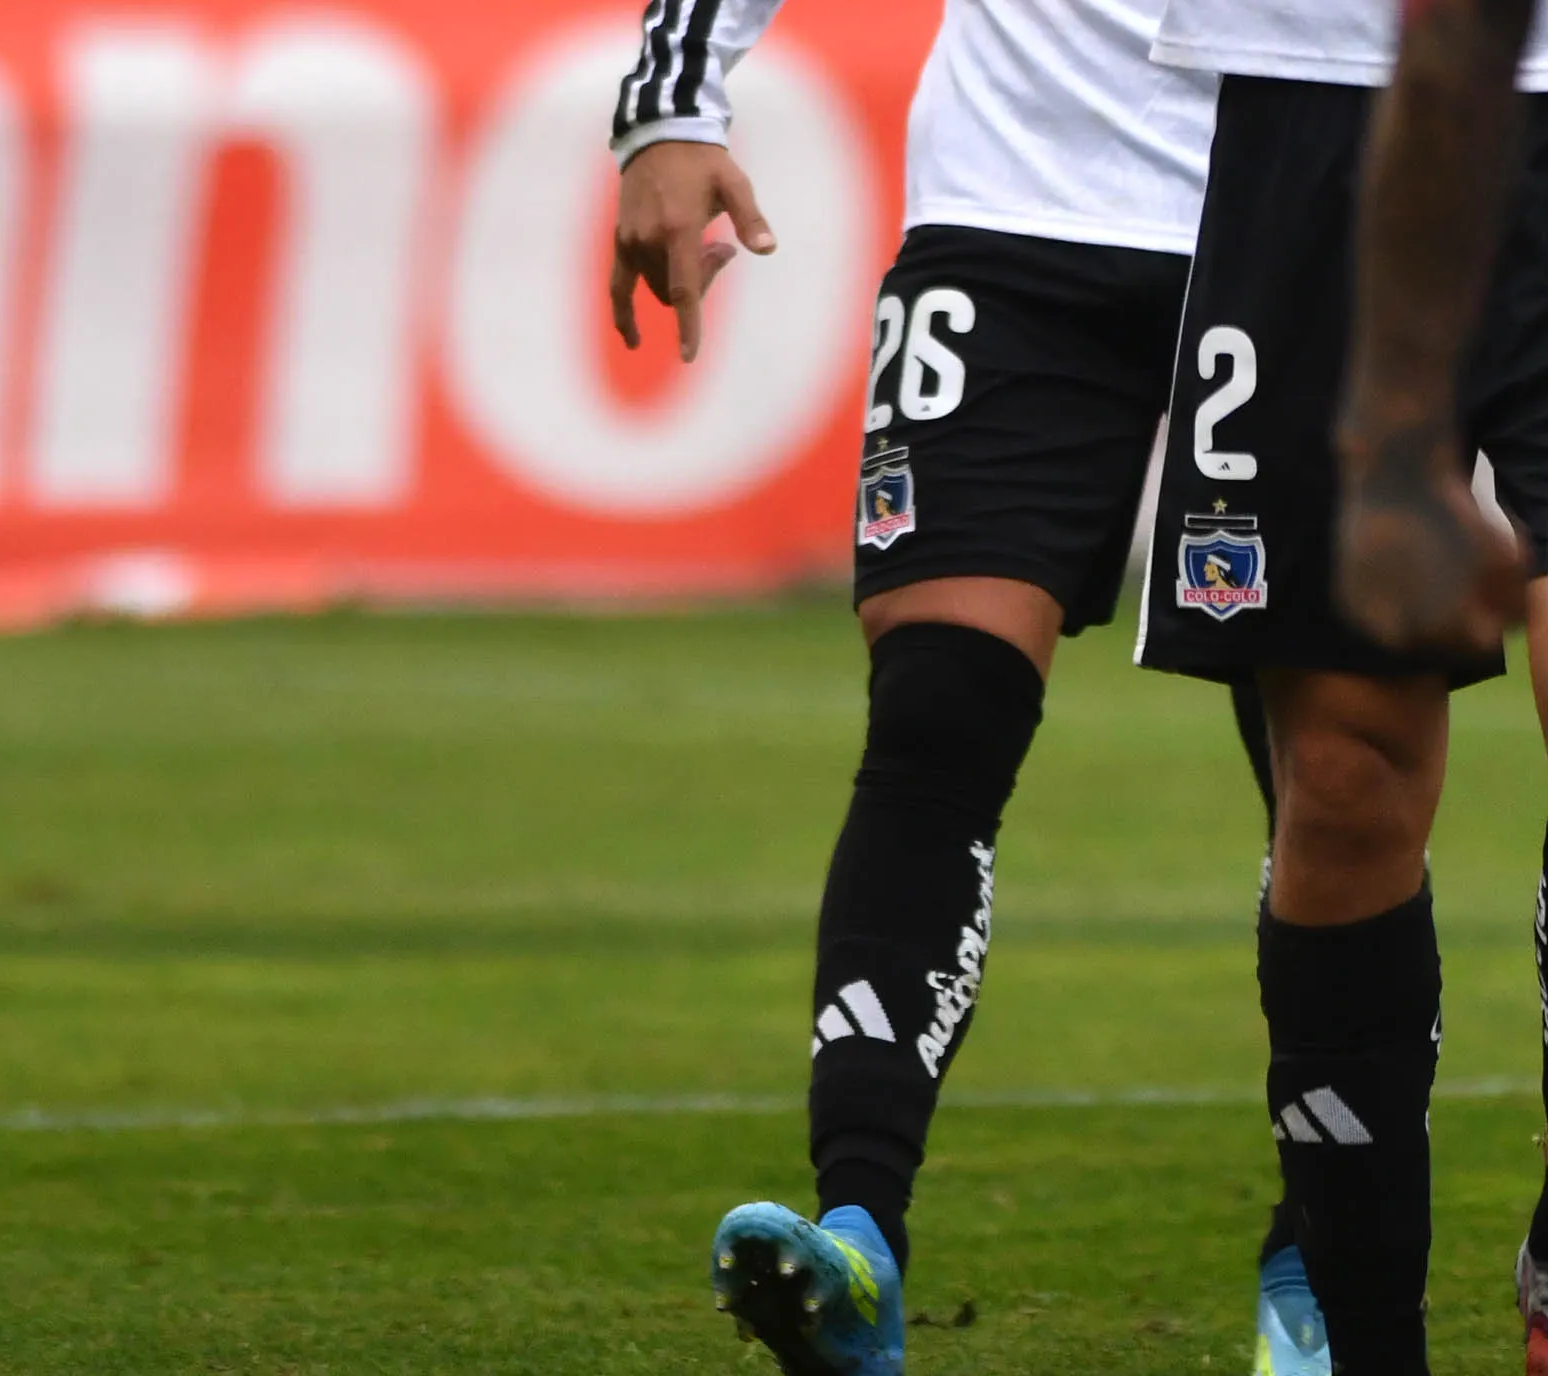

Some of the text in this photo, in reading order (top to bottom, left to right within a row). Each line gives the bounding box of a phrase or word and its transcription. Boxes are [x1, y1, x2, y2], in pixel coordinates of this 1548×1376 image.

[865, 288, 976, 434] 26
[1194, 326, 1258, 480] 2
[1186, 591, 1257, 602] COLO-COLO
